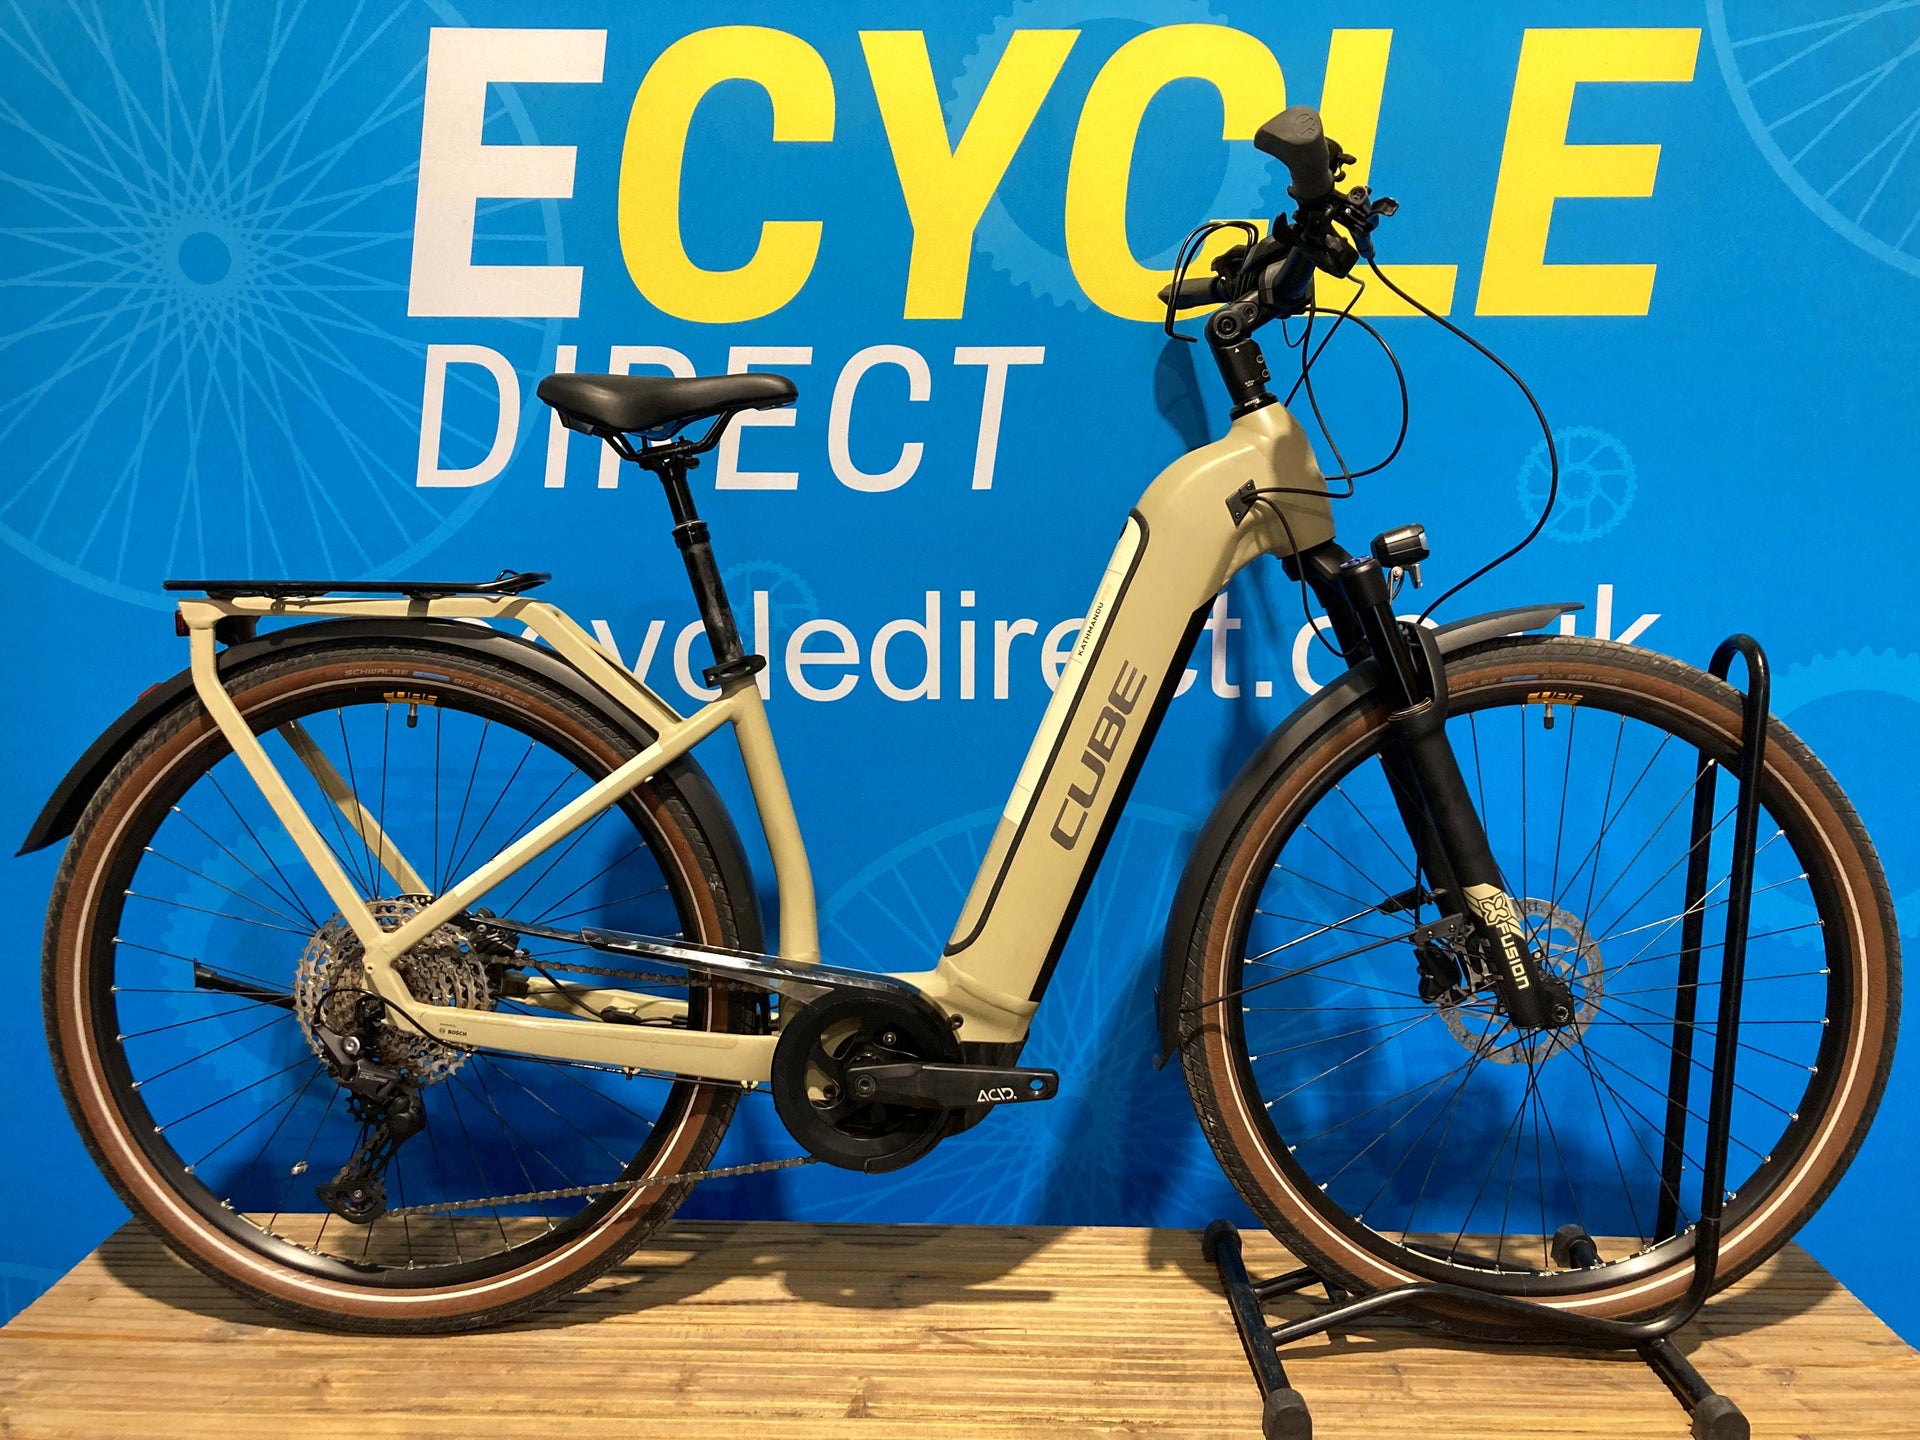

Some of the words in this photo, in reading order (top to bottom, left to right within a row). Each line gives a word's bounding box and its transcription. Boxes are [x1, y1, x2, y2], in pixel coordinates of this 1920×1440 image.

[408, 24, 1702, 323] ECYCLE
[416, 344, 1044, 492] DIRECT
[1078, 602, 1104, 656] KATHMANDU
[345, 668, 409, 676] SCHWALBE
[1050, 659, 1148, 850] CUBE
[1496, 922, 1530, 990] FUSION
[447, 1029, 468, 1037] BOSCH
